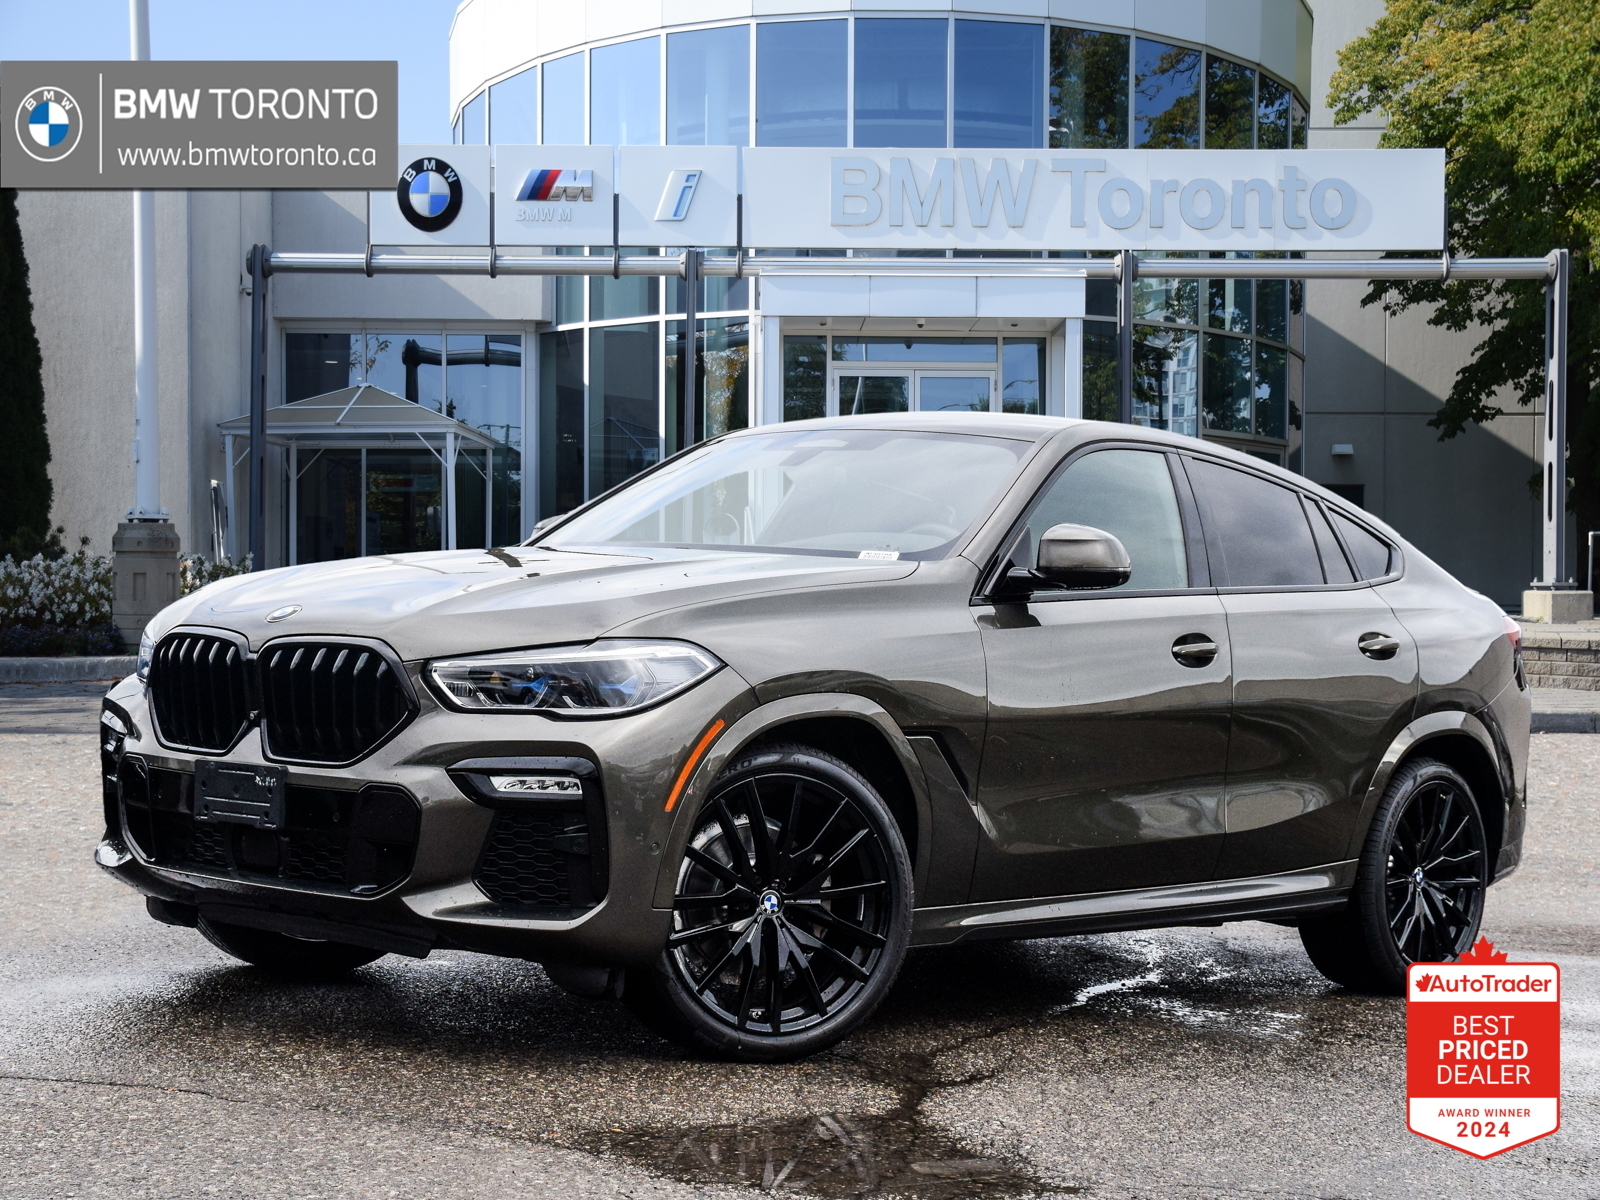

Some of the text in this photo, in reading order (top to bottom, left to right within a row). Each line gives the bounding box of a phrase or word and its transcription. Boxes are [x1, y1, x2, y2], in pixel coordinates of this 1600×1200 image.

[403, 159, 458, 183] BMW
[830, 156, 1357, 231] BMW Toronto
[515, 207, 572, 221] BMW M
